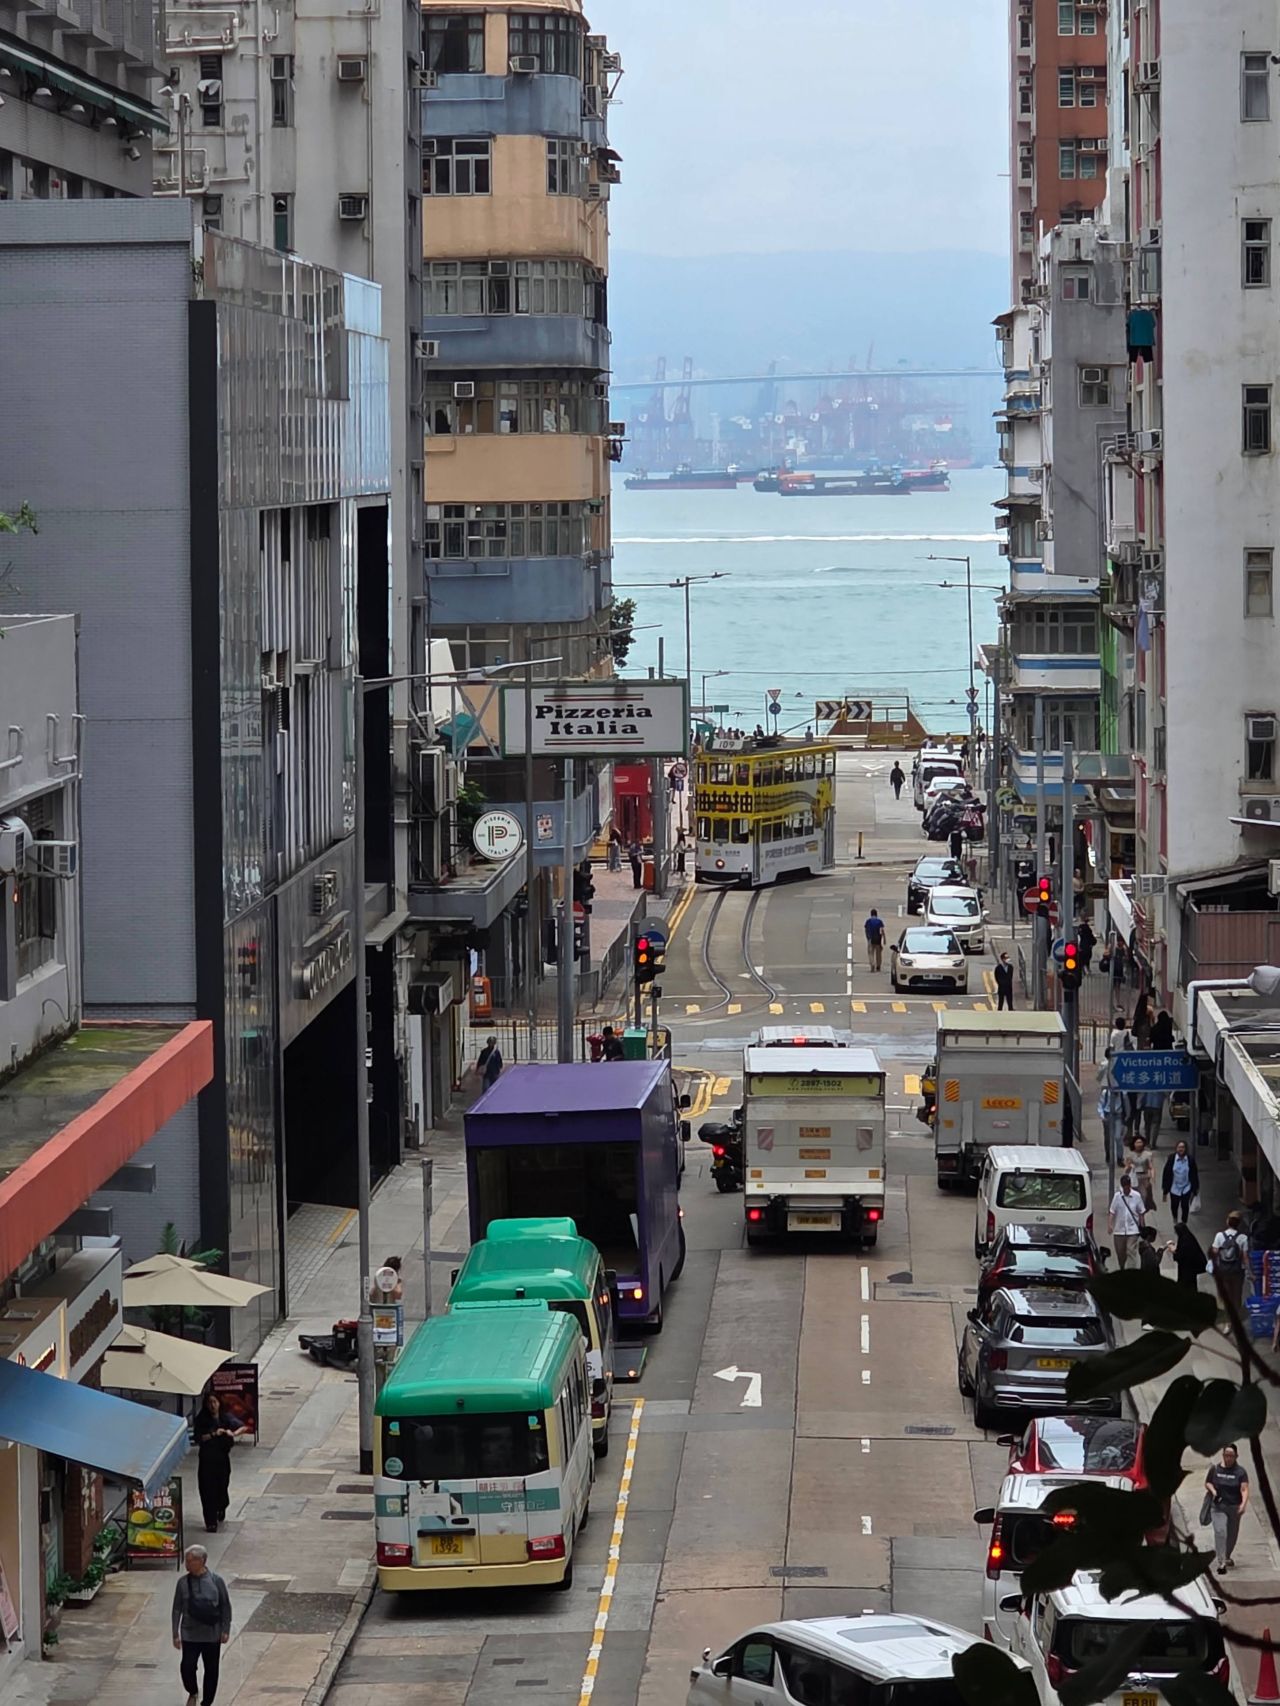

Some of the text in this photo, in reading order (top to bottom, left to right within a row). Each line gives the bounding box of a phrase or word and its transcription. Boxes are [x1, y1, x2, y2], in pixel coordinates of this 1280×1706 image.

[535, 704, 653, 719] Pizzeria
[550, 720, 639, 735] Italia
[719, 740, 736, 749] 109
[1121, 1057, 1162, 1067] Victoria
[1121, 1070, 1182, 1085] 域多利道
[434, 1543, 460, 1553] 1392
